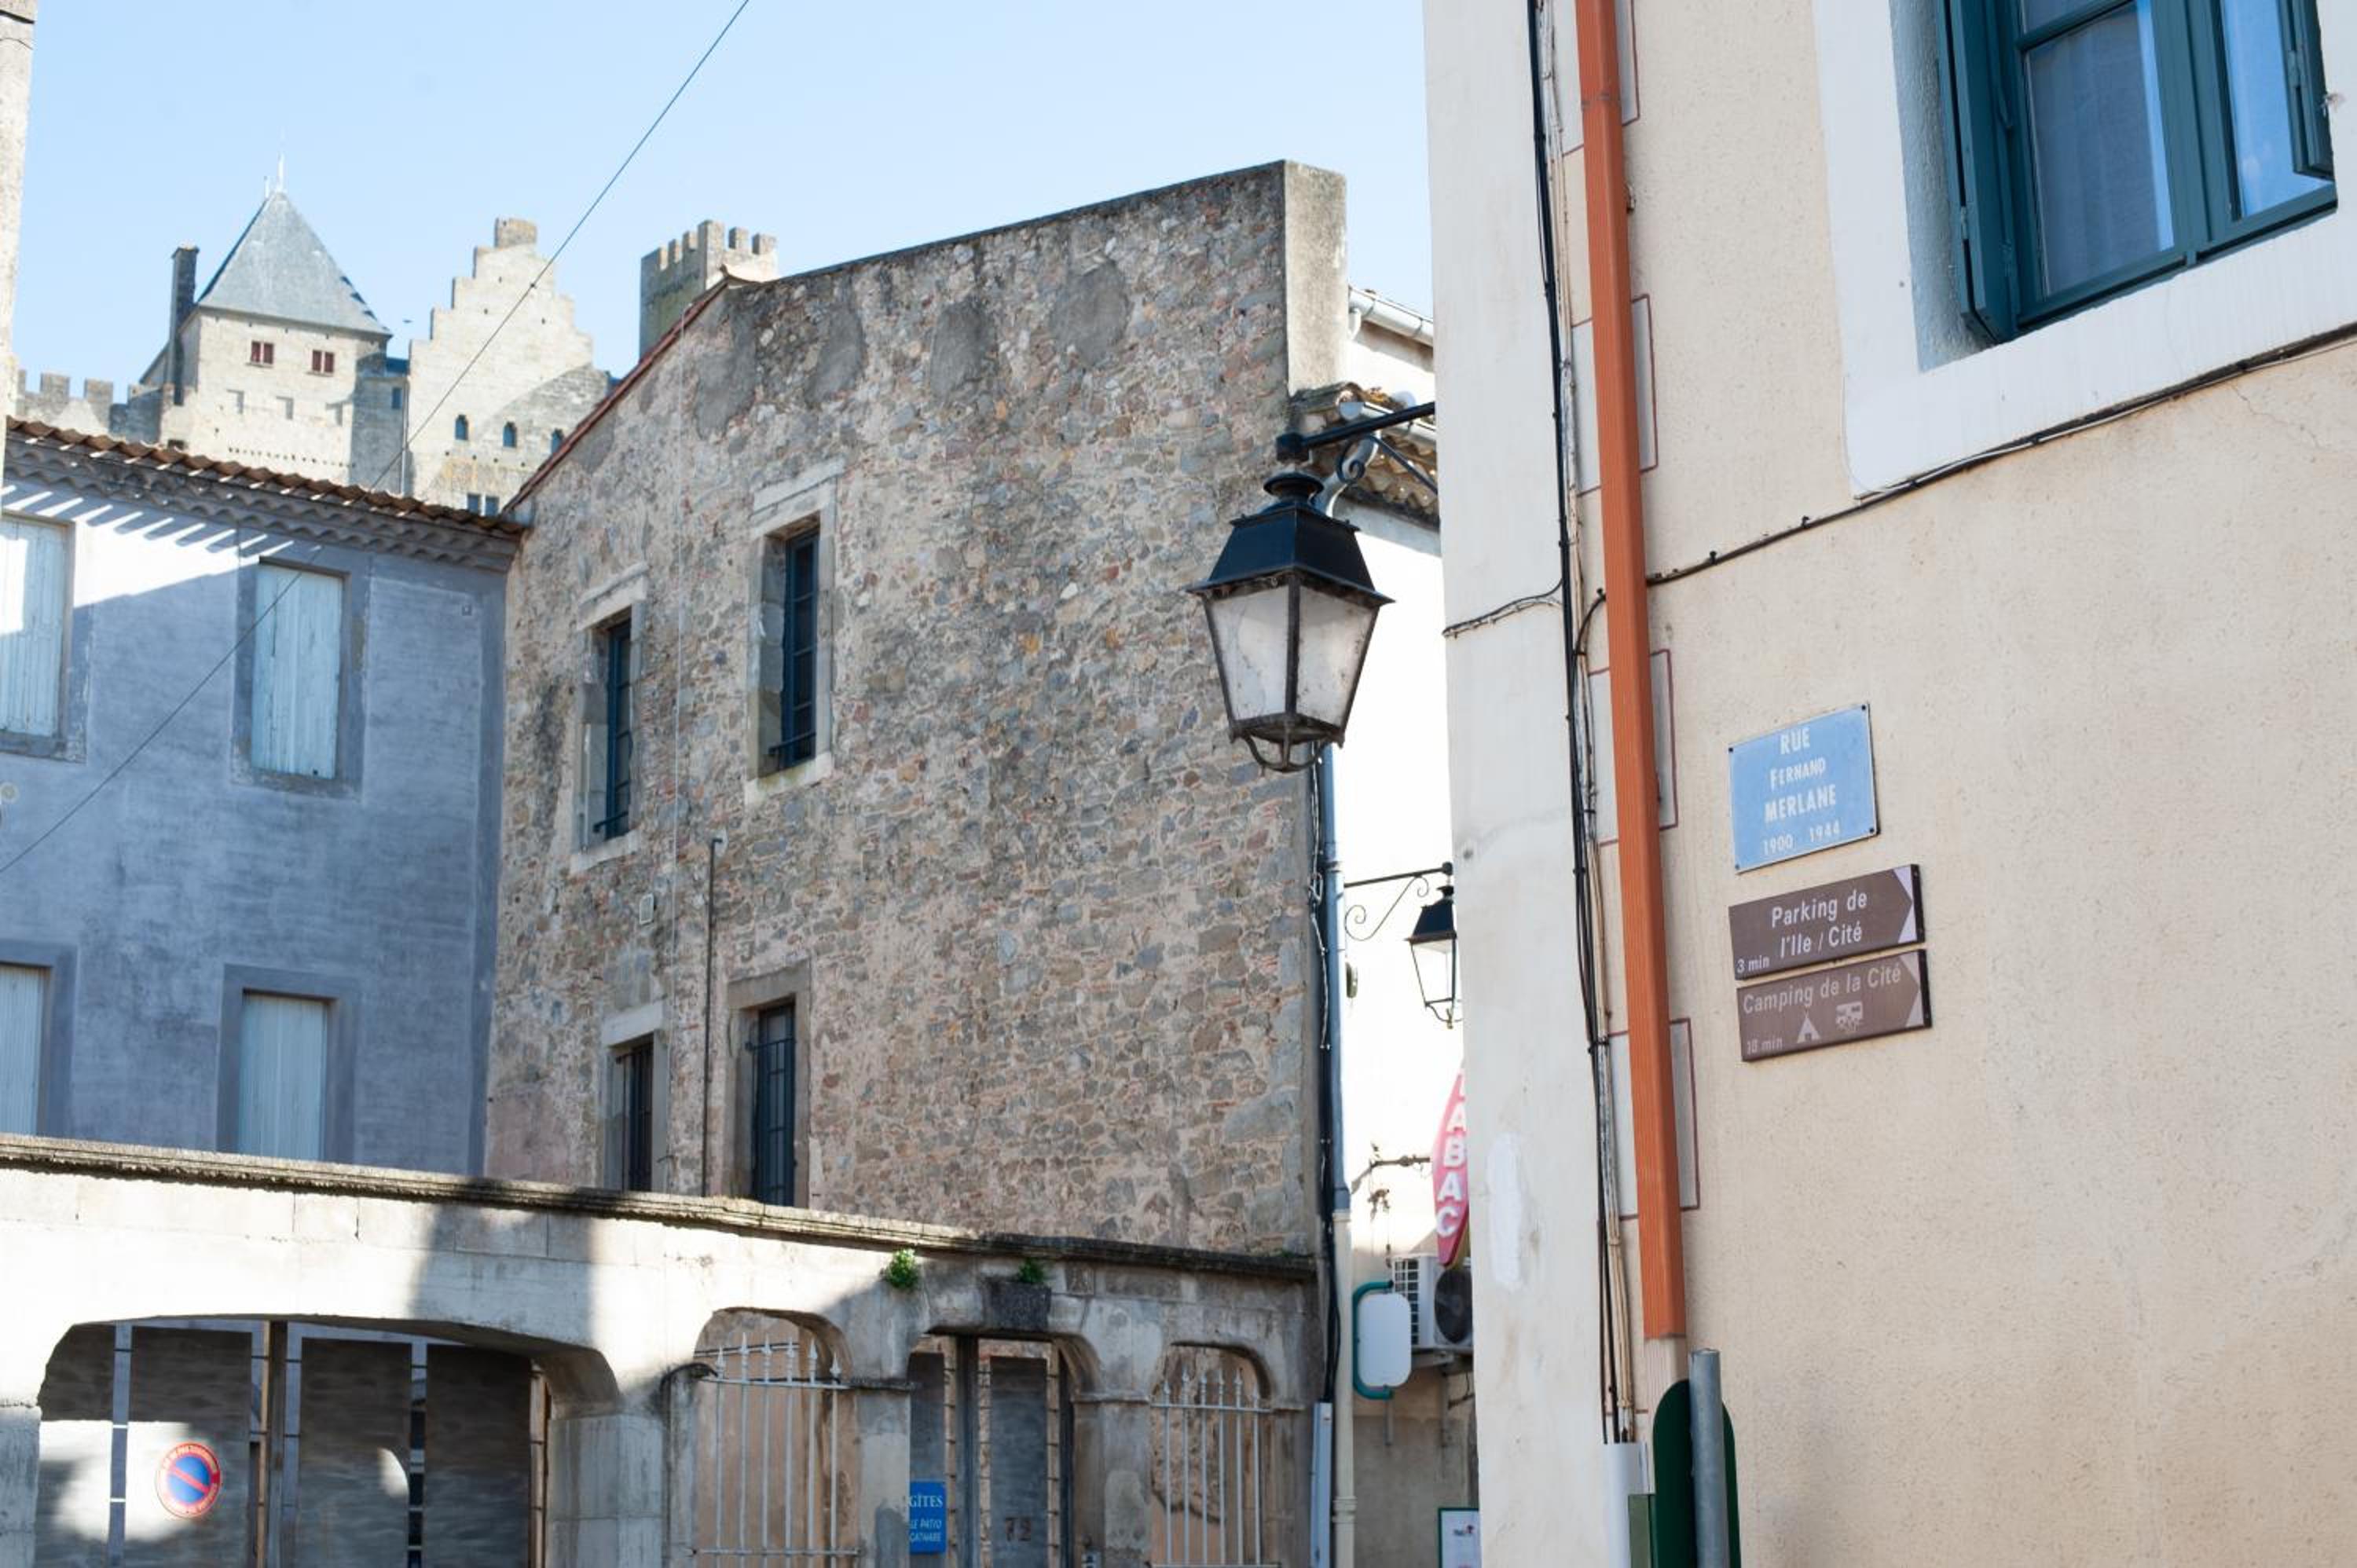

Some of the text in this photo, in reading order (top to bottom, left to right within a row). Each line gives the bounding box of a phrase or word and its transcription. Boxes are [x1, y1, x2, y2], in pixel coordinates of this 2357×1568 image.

[1780, 727, 1810, 754] RUE
[1770, 757, 1826, 790] FERNAND
[1765, 784, 1836, 822] MERLANE
[1763, 820, 1840, 855] 1900 1944
[1772, 889, 1867, 928] Parking de
[1828, 921, 1862, 947] Cité
[1737, 955, 1769, 973] 3 min
[1743, 963, 1901, 1013] Camping de la Cité
[1761, 1035, 1783, 1050] min
